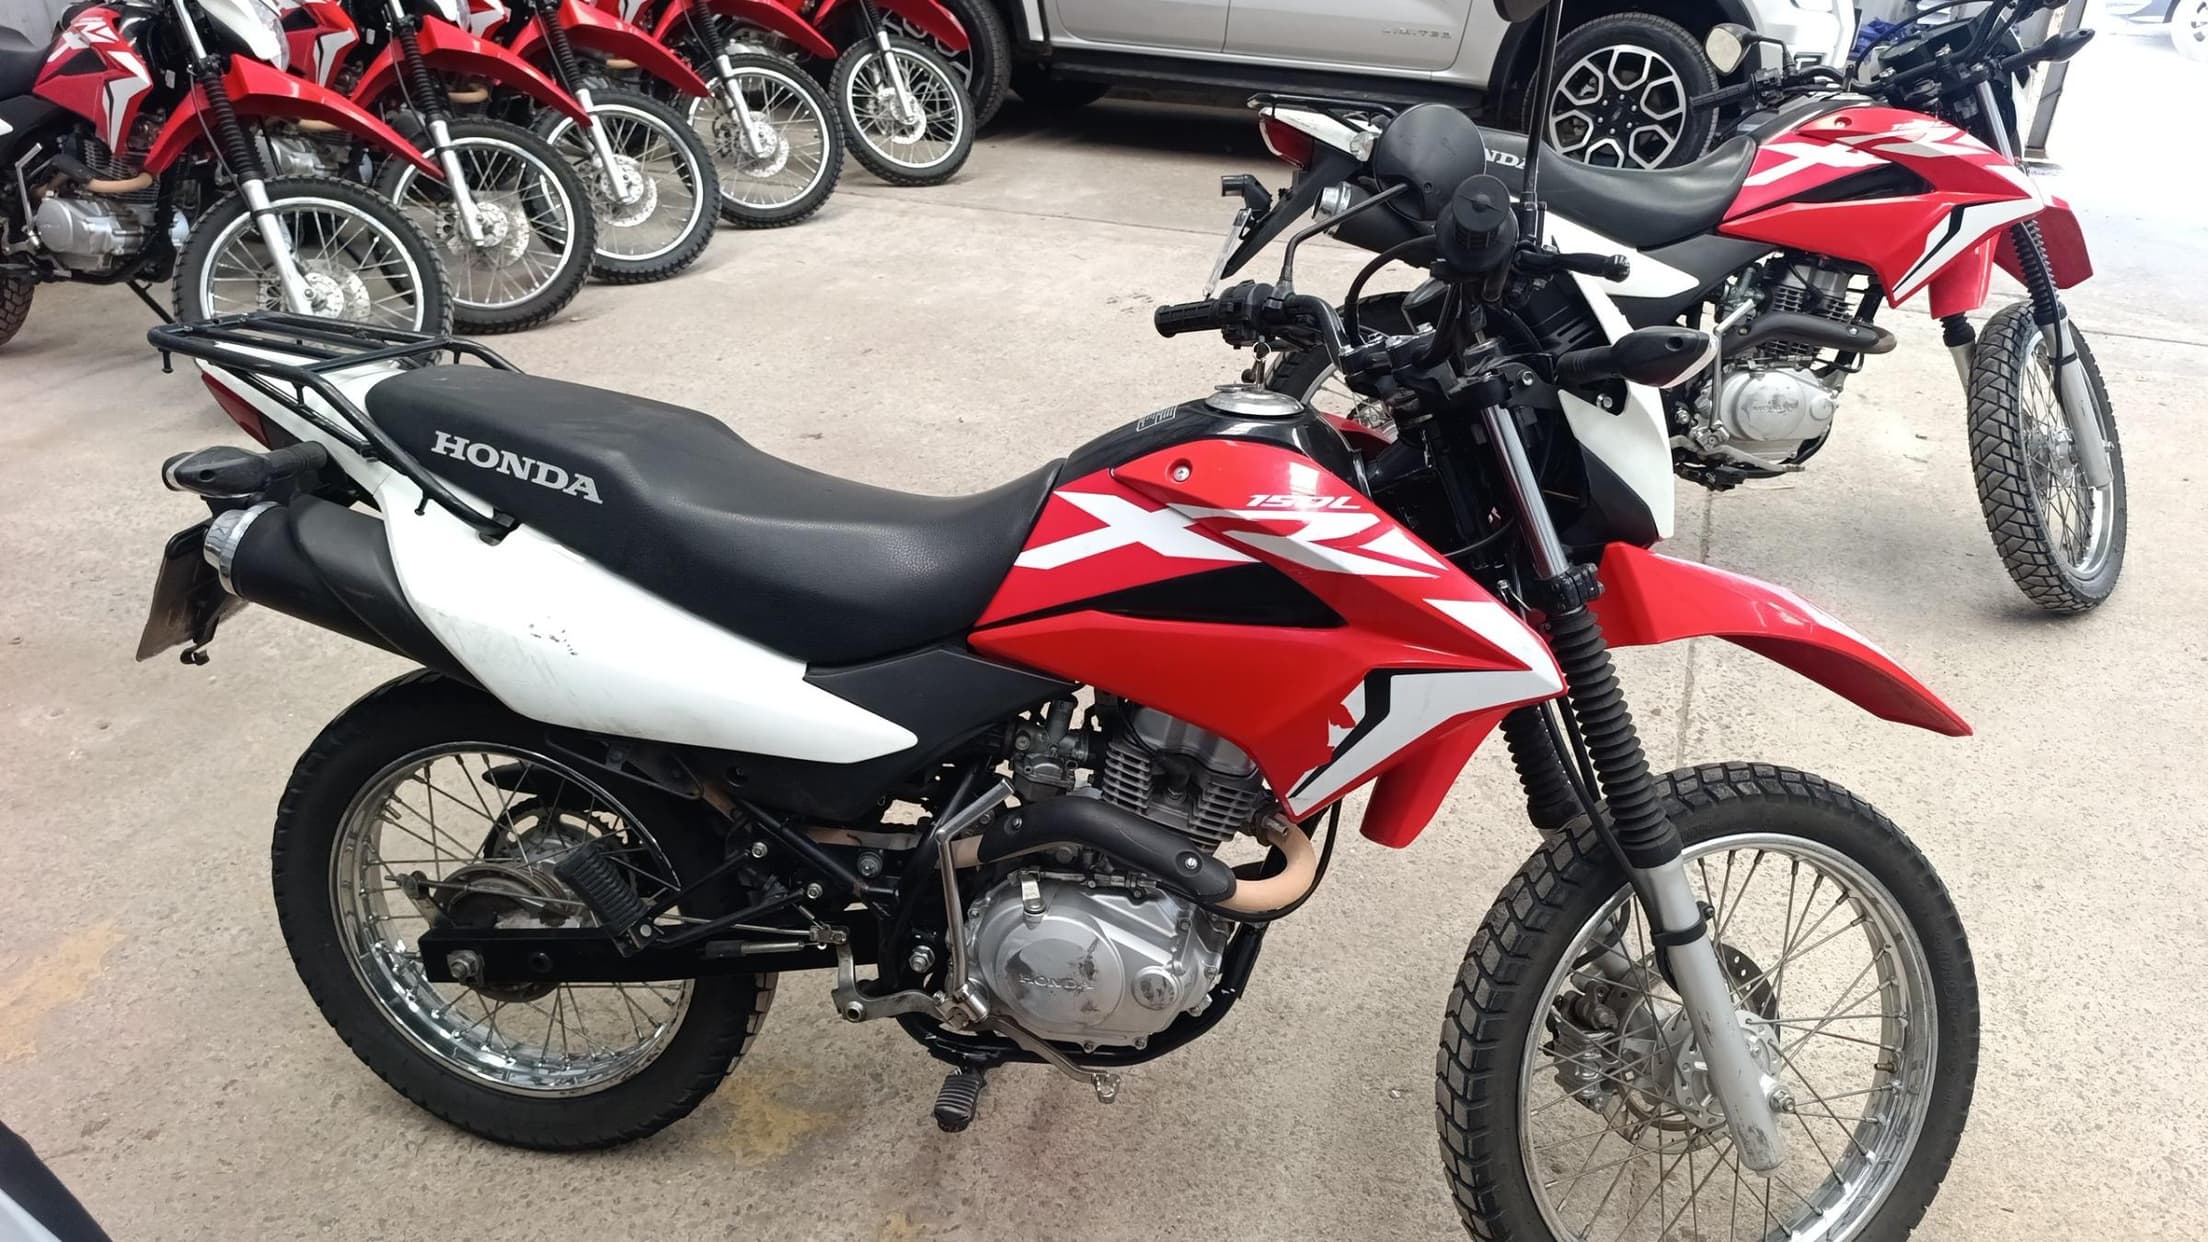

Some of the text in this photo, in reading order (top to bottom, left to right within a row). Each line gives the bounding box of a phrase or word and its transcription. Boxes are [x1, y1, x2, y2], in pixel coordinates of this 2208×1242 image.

[431, 430, 603, 504] HONDA
[1246, 494, 1360, 510] 150L
[1019, 974, 1097, 992] HONDA
